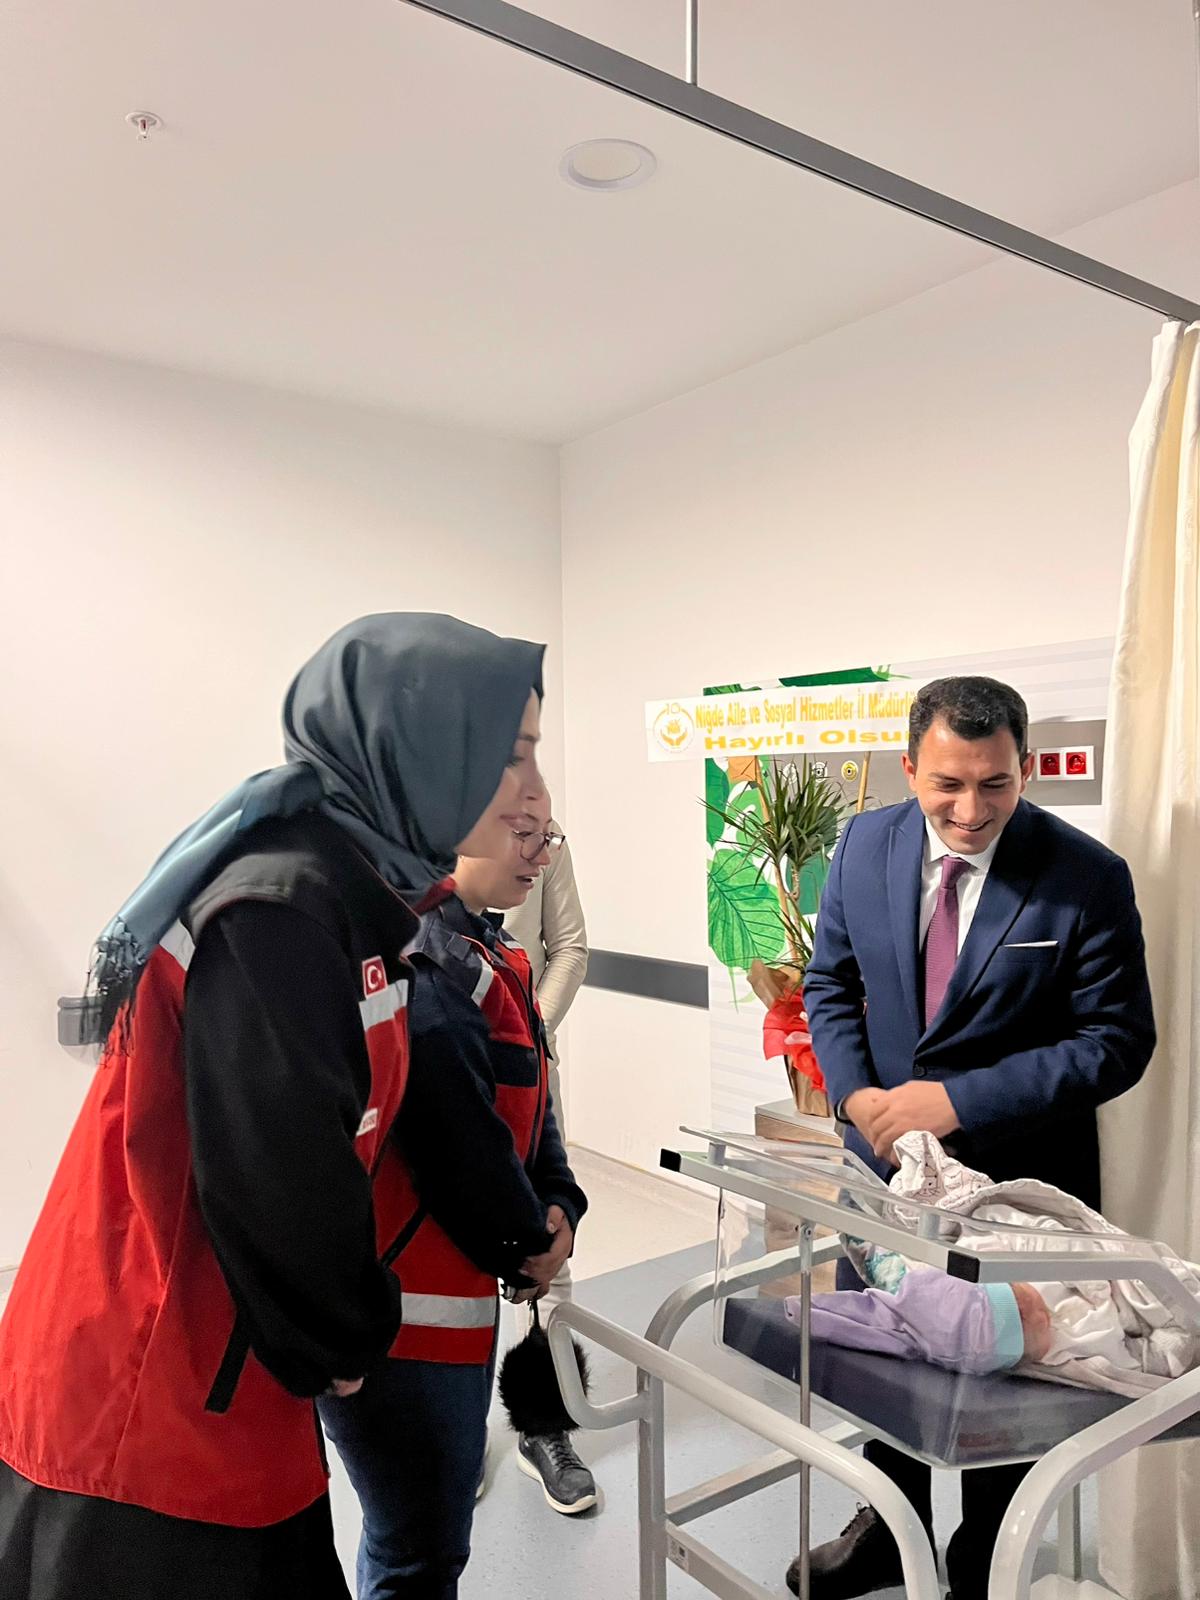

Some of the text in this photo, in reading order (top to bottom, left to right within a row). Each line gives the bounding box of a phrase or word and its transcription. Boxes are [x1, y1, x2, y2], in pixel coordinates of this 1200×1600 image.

[696, 703, 724, 734] Niğde
[728, 702, 746, 726] Aile
[750, 706, 760, 723] ve
[764, 697, 795, 729] Sosyal
[801, 696, 853, 721] Hizmetler
[705, 731, 804, 751] Hayırlı
